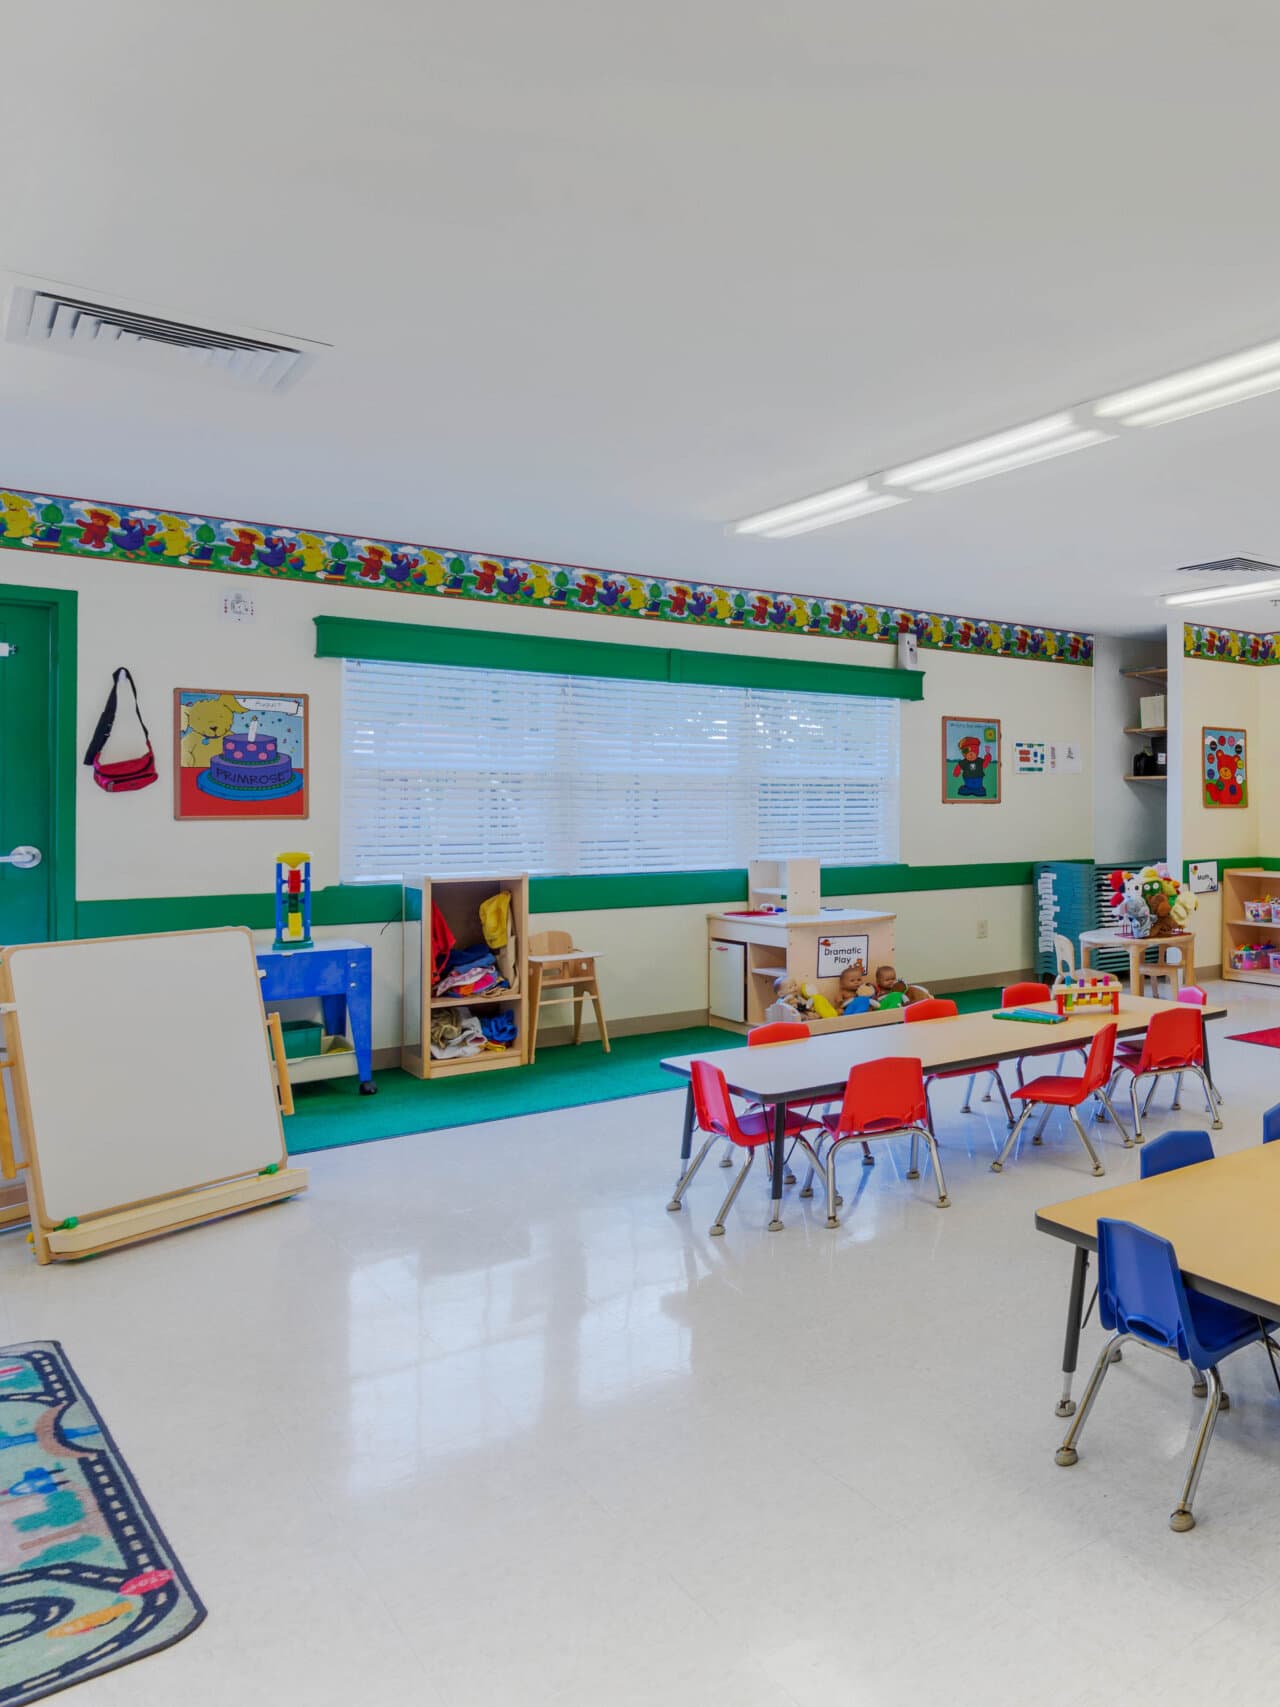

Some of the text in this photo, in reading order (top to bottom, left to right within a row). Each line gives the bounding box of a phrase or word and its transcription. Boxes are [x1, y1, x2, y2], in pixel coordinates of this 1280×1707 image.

[216, 767, 285, 785] PRIMROSE
[824, 947, 862, 956] Dramatic
[834, 956, 851, 964] Play
